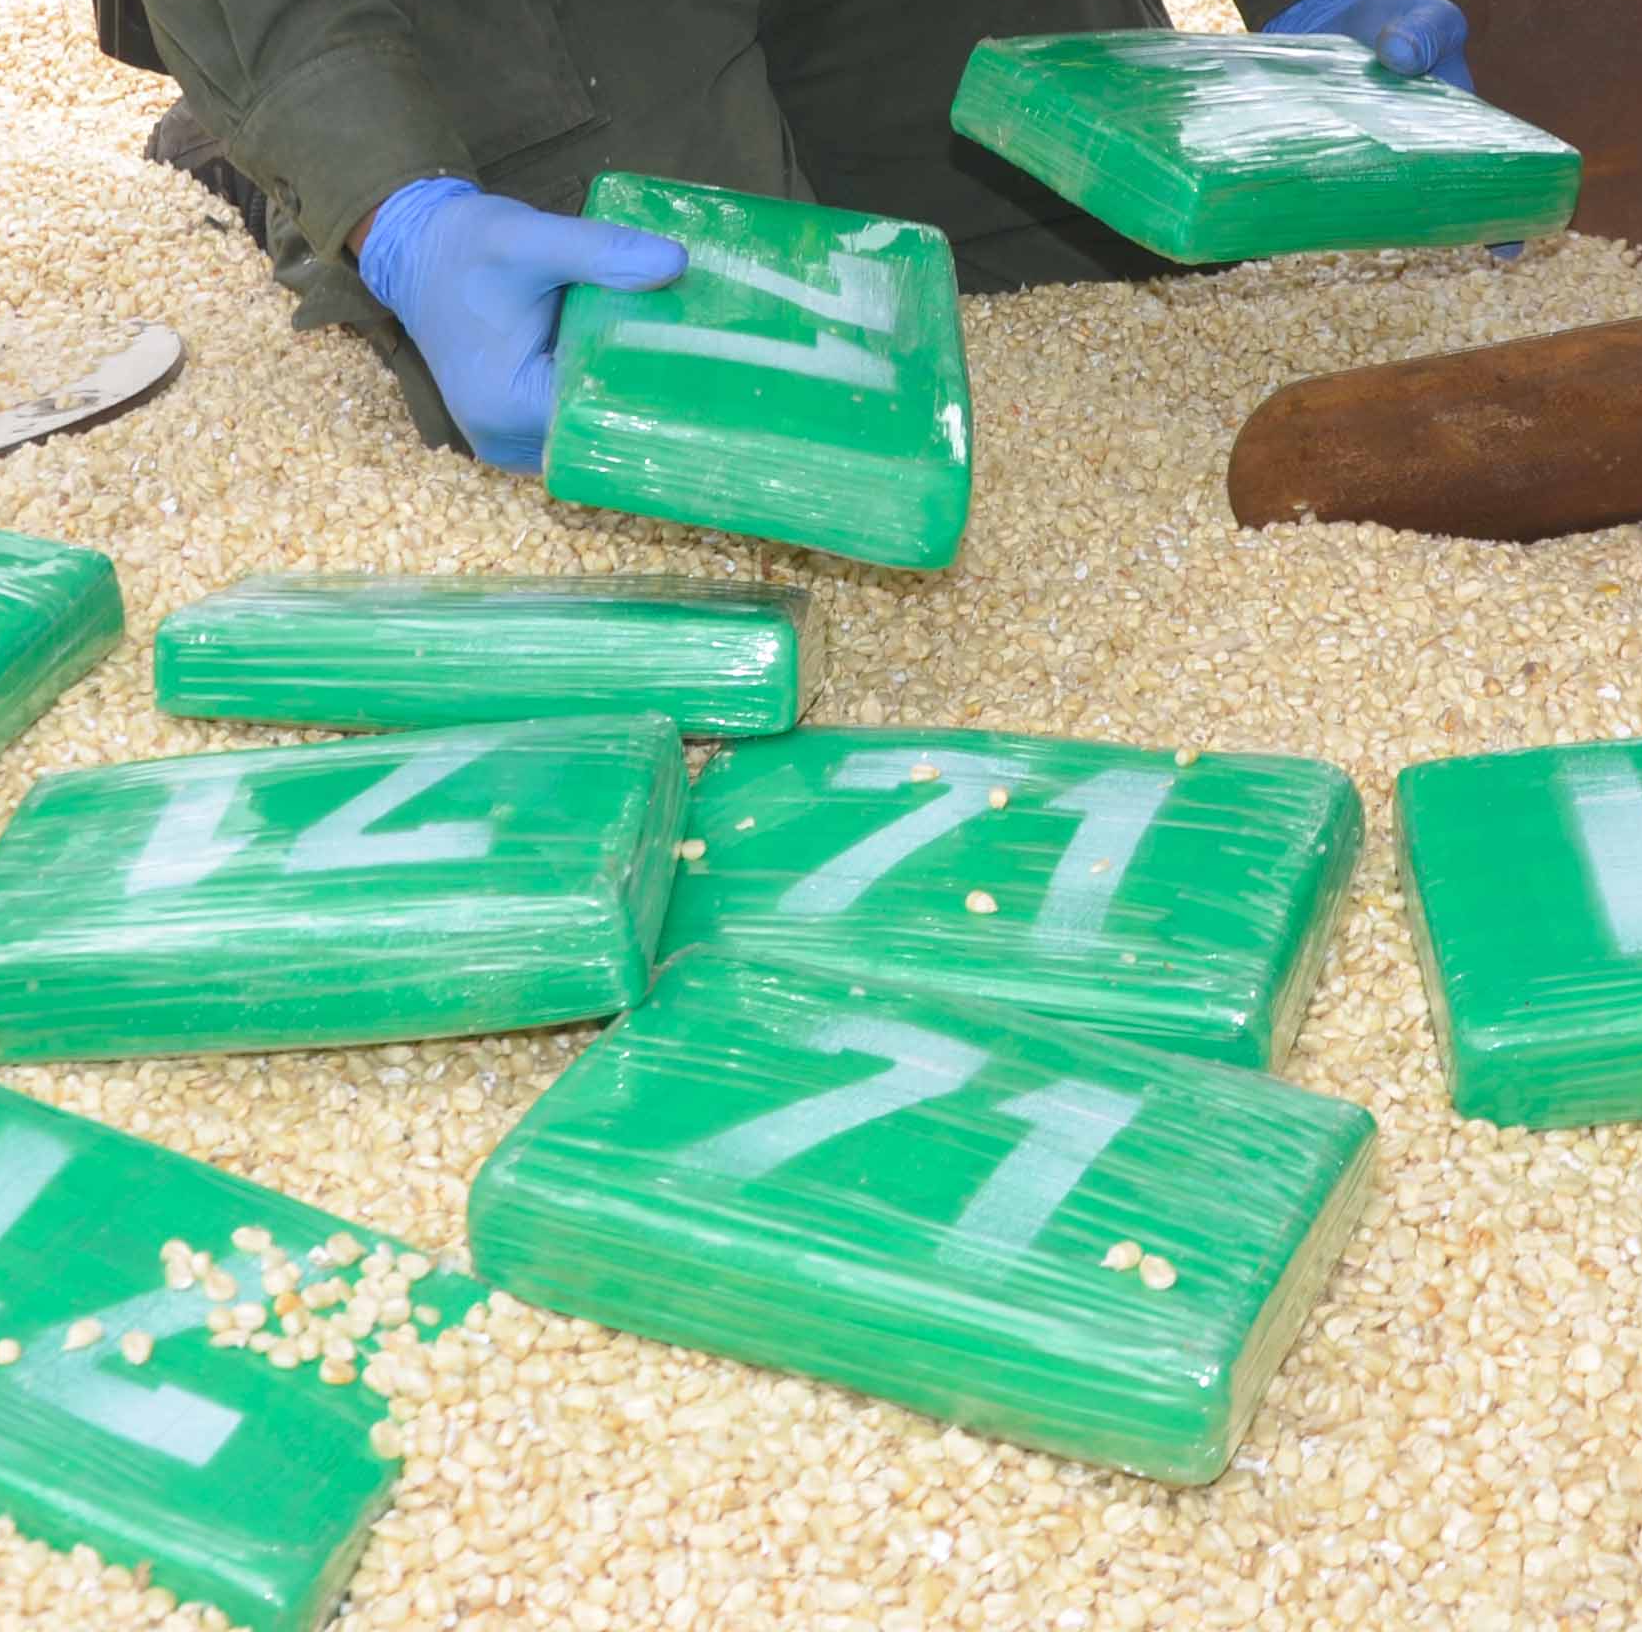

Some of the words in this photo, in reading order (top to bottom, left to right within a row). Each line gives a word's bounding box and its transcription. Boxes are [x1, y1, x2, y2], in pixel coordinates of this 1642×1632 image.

[123, 725, 515, 894] 71
[776, 749, 1177, 954] 71
[675, 1014, 1145, 1270] 71
